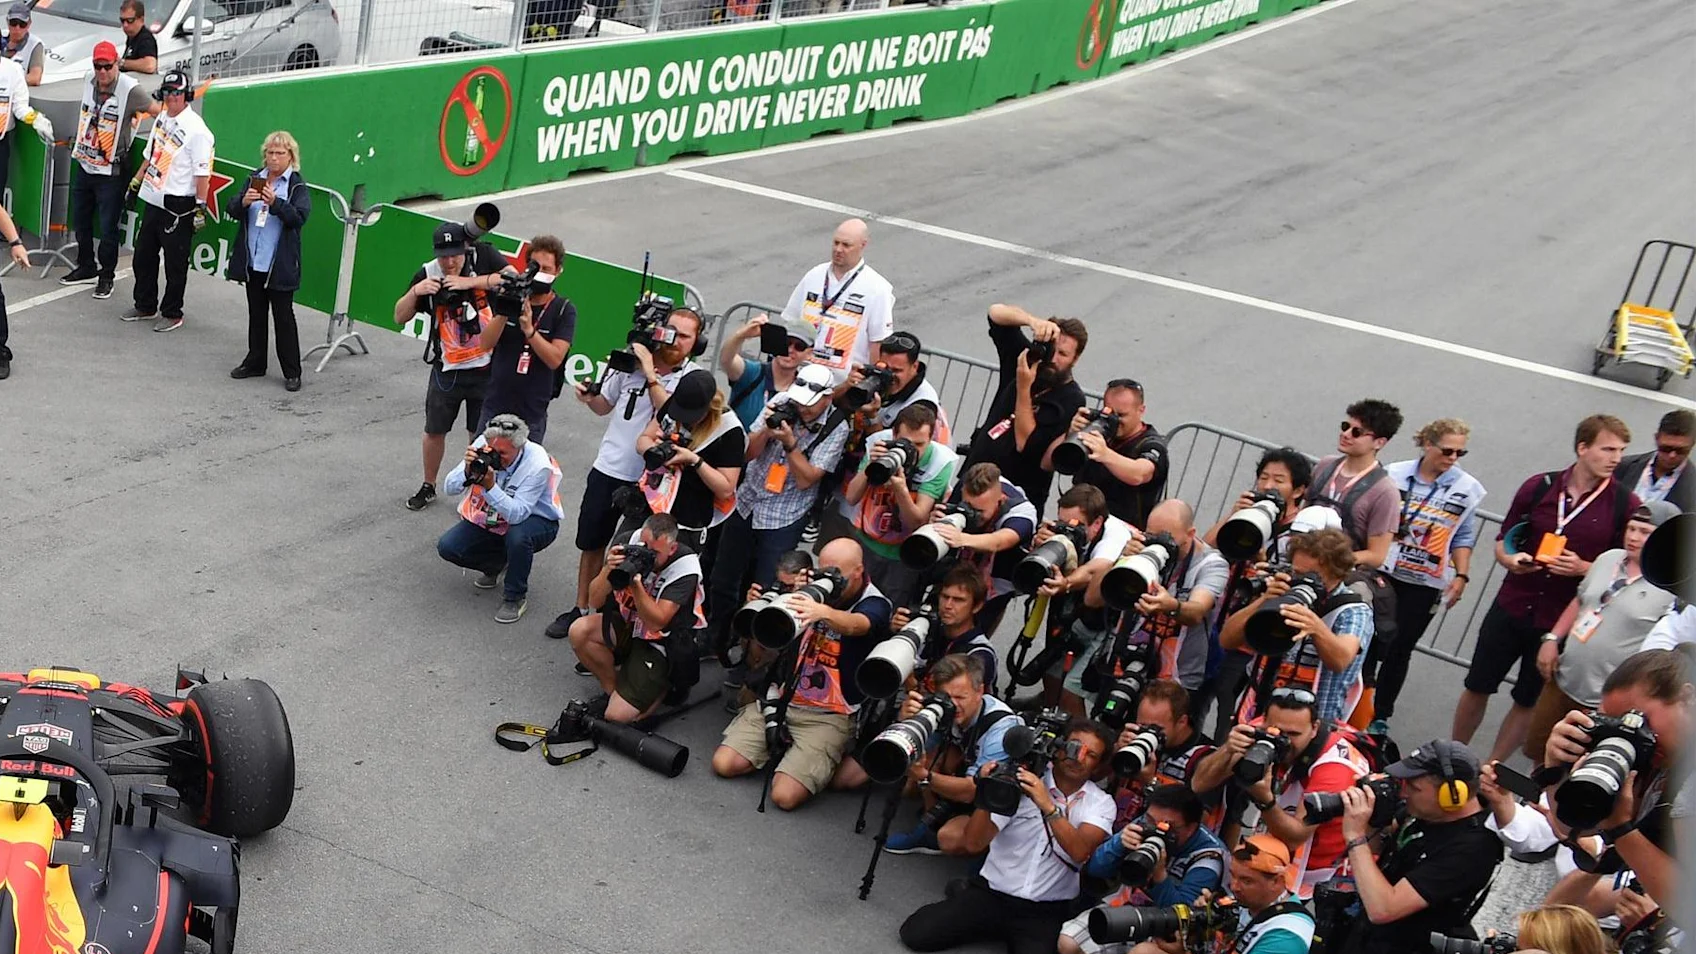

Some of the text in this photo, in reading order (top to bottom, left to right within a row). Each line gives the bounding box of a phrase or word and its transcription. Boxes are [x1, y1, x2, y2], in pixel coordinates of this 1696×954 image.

[1109, 23, 1148, 59] WHEN
[1145, 15, 1173, 47] YOU
[543, 66, 650, 117] QUAND
[657, 59, 704, 100] ON
[707, 46, 824, 94] CONDUIT
[827, 39, 871, 78] ON
[867, 34, 901, 72] NE
[904, 29, 959, 67] BOIT
[537, 73, 926, 163] WHEN YOU DRIVE NEVER DRINK
[0, 759, 75, 777] Red Bull
